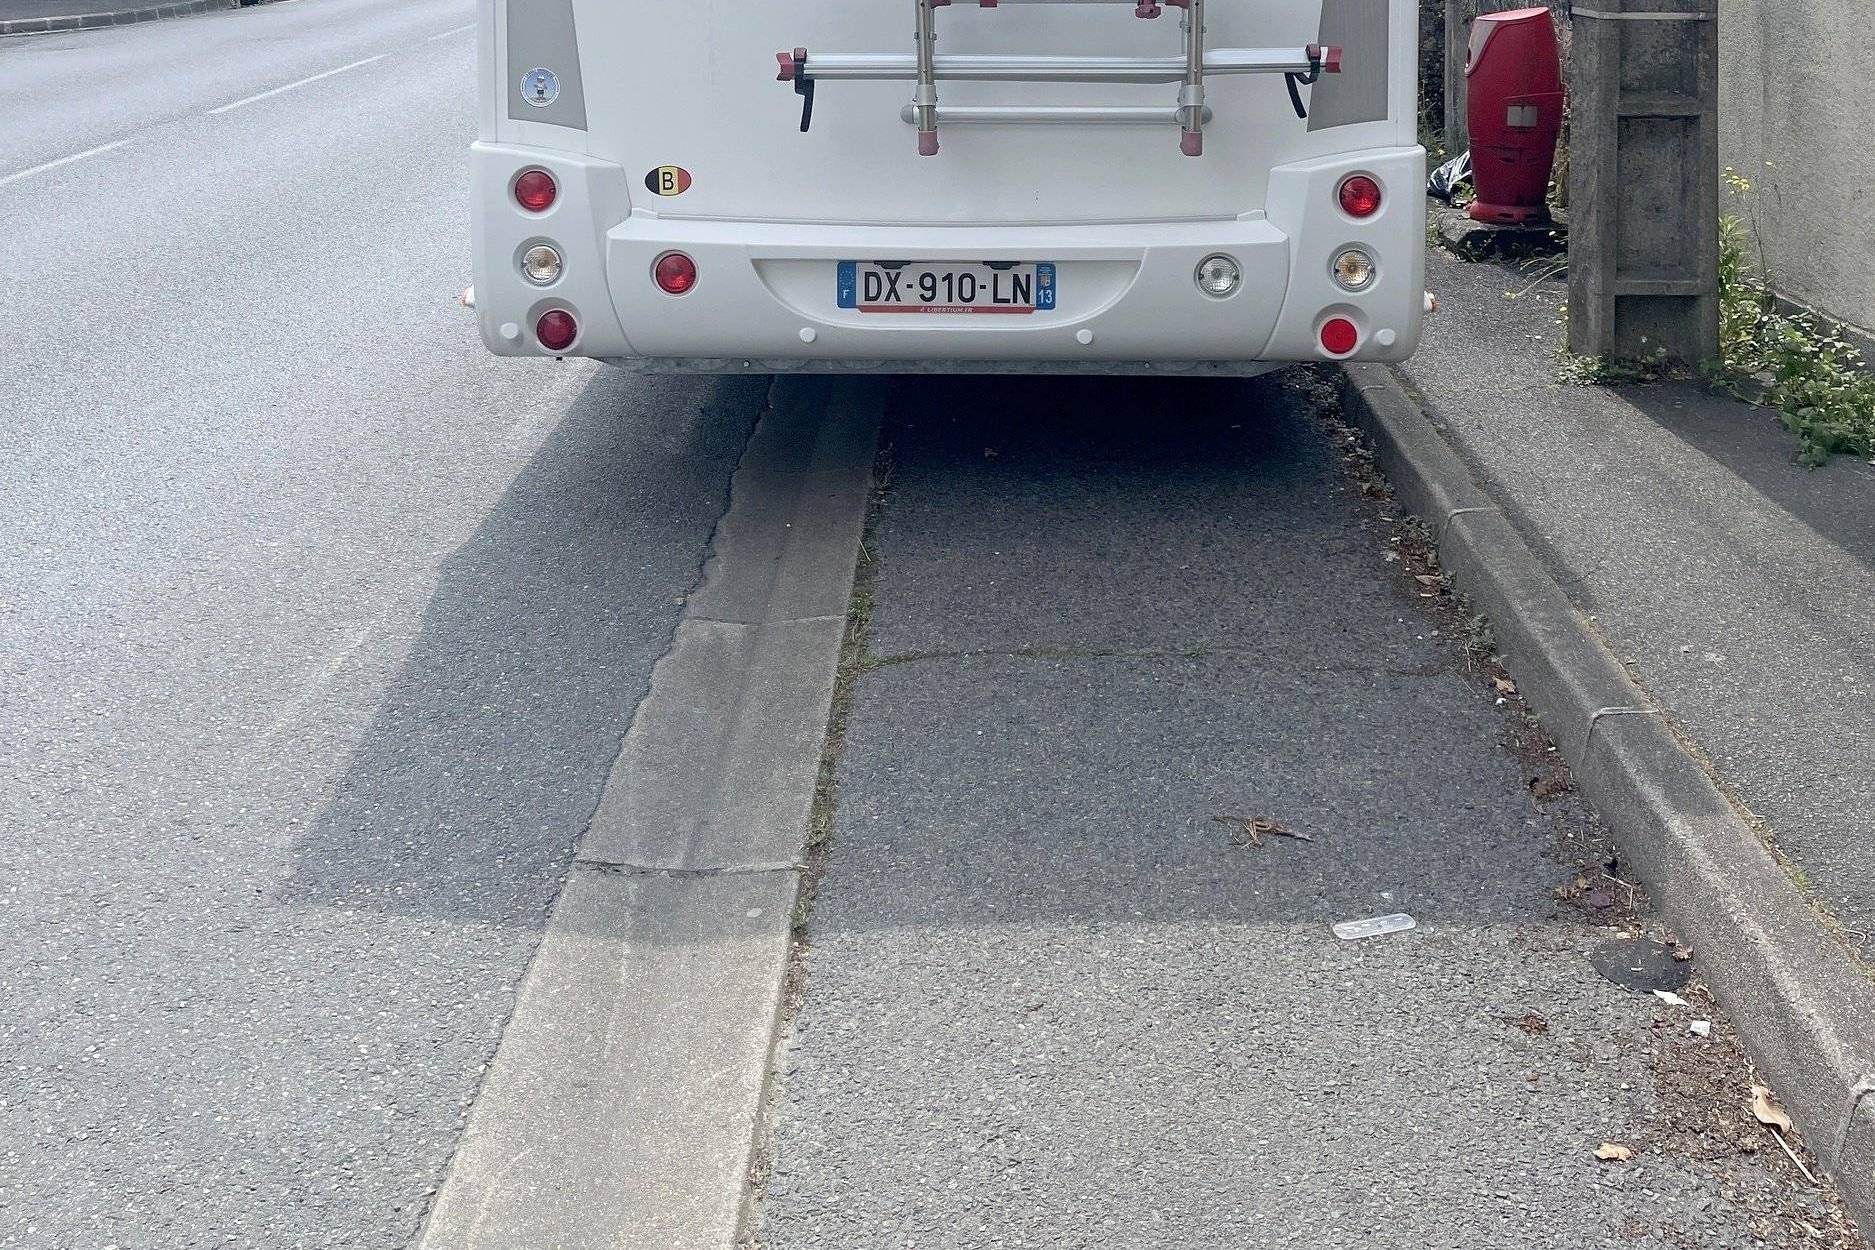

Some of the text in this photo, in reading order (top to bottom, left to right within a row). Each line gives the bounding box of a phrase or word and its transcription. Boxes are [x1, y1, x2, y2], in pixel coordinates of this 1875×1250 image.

[662, 171, 674, 191] B
[843, 290, 850, 299] F
[864, 271, 1031, 304] DX-910-LN
[1038, 289, 1053, 304] 13
